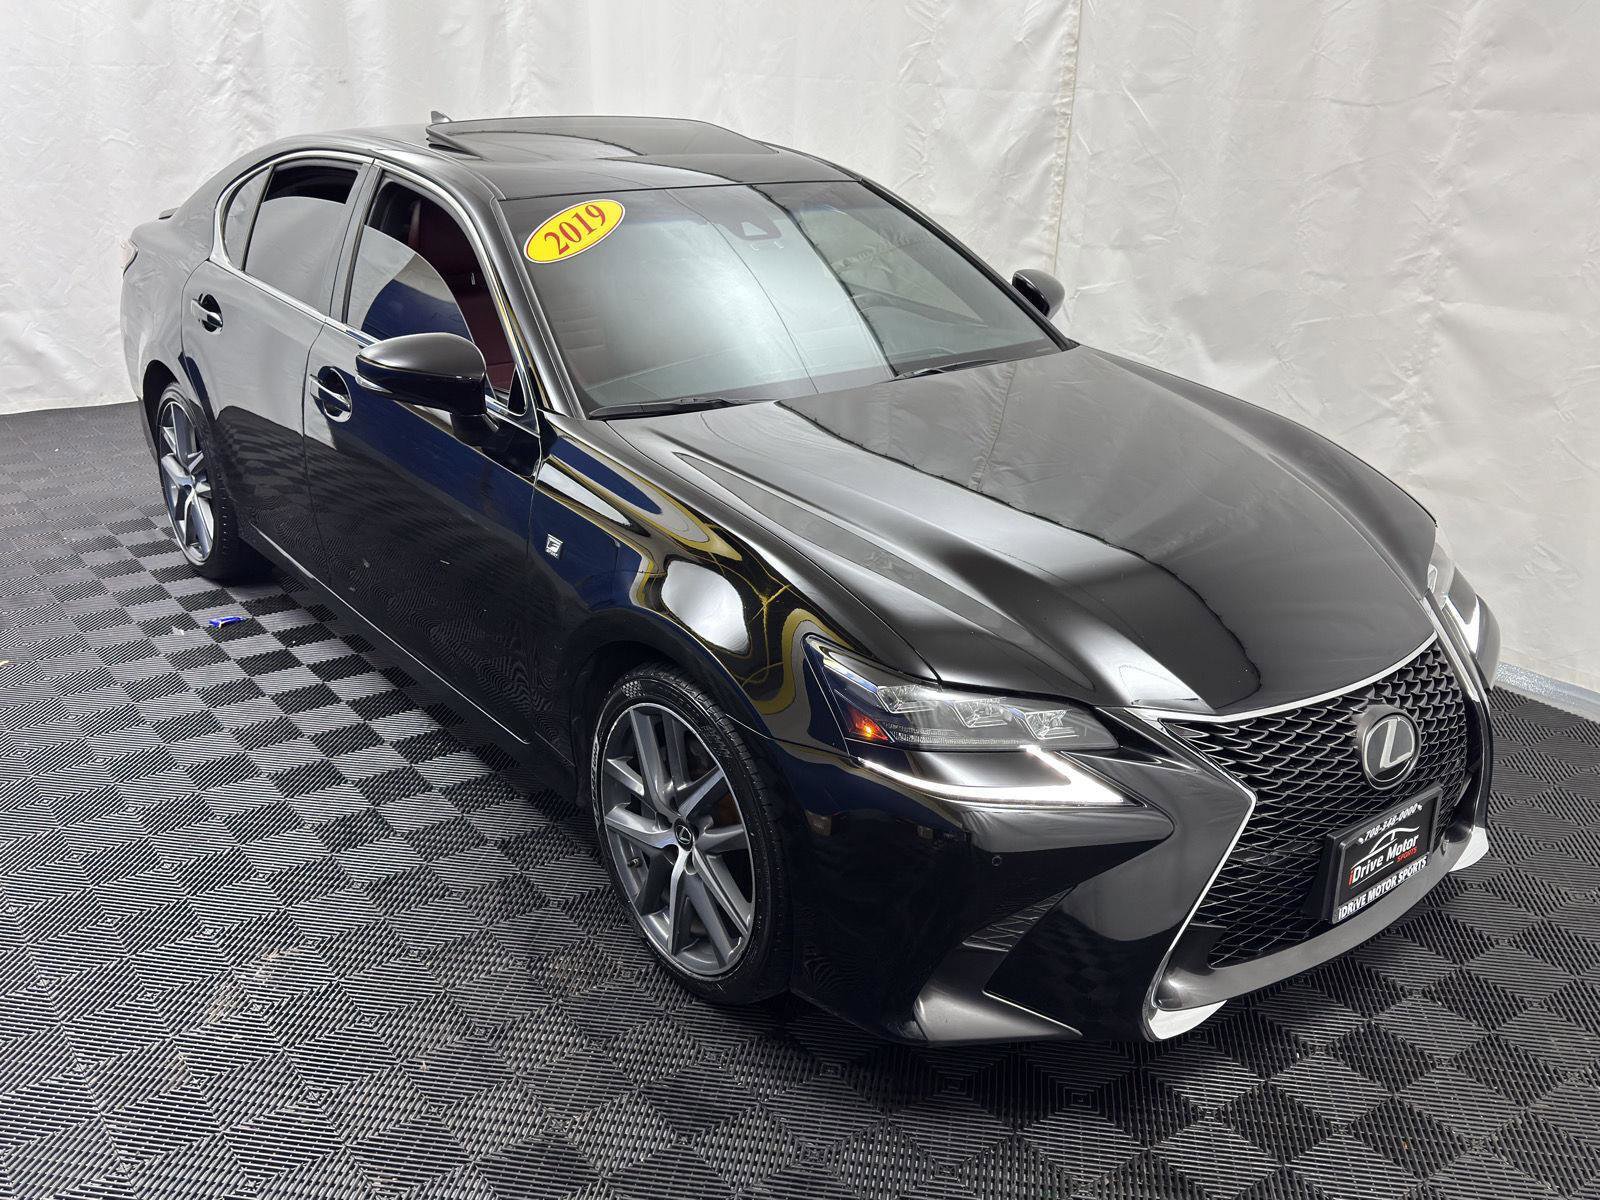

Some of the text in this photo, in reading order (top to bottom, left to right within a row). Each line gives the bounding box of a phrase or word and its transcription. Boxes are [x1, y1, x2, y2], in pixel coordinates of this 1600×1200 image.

[543, 204, 606, 255] 2019
[1347, 835, 1419, 887] iDrive Motor
[1396, 846, 1418, 862] SPORTS
[1367, 874, 1397, 903] MOTOR
[1397, 855, 1428, 883] SPORTS
